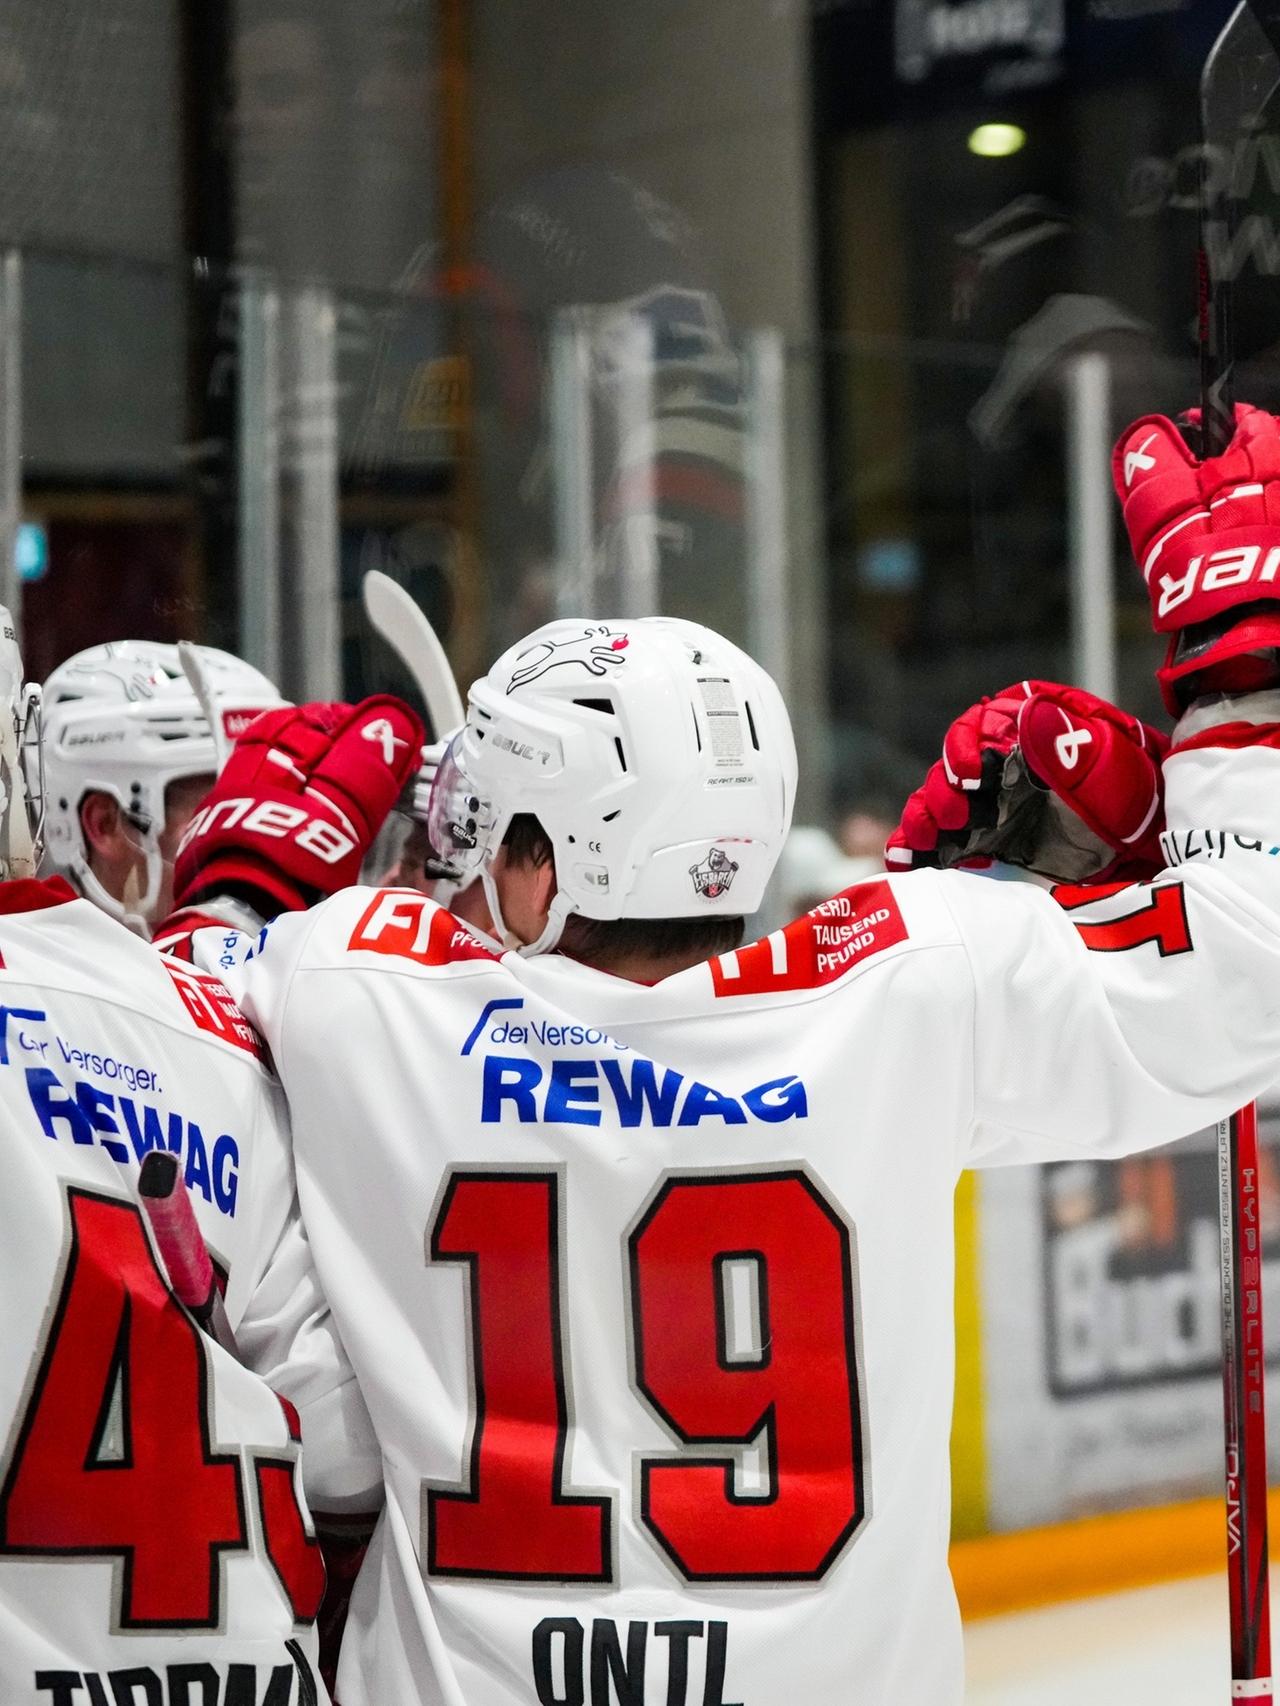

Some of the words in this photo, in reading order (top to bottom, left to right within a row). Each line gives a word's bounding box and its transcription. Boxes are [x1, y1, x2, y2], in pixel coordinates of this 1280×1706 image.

[813, 908, 891, 945] TAUSEND
[817, 932, 876, 973] PFUND
[481, 1055, 808, 1128] REWAG
[25, 1067, 239, 1218] REWAG
[422, 1162, 870, 1586] 19
